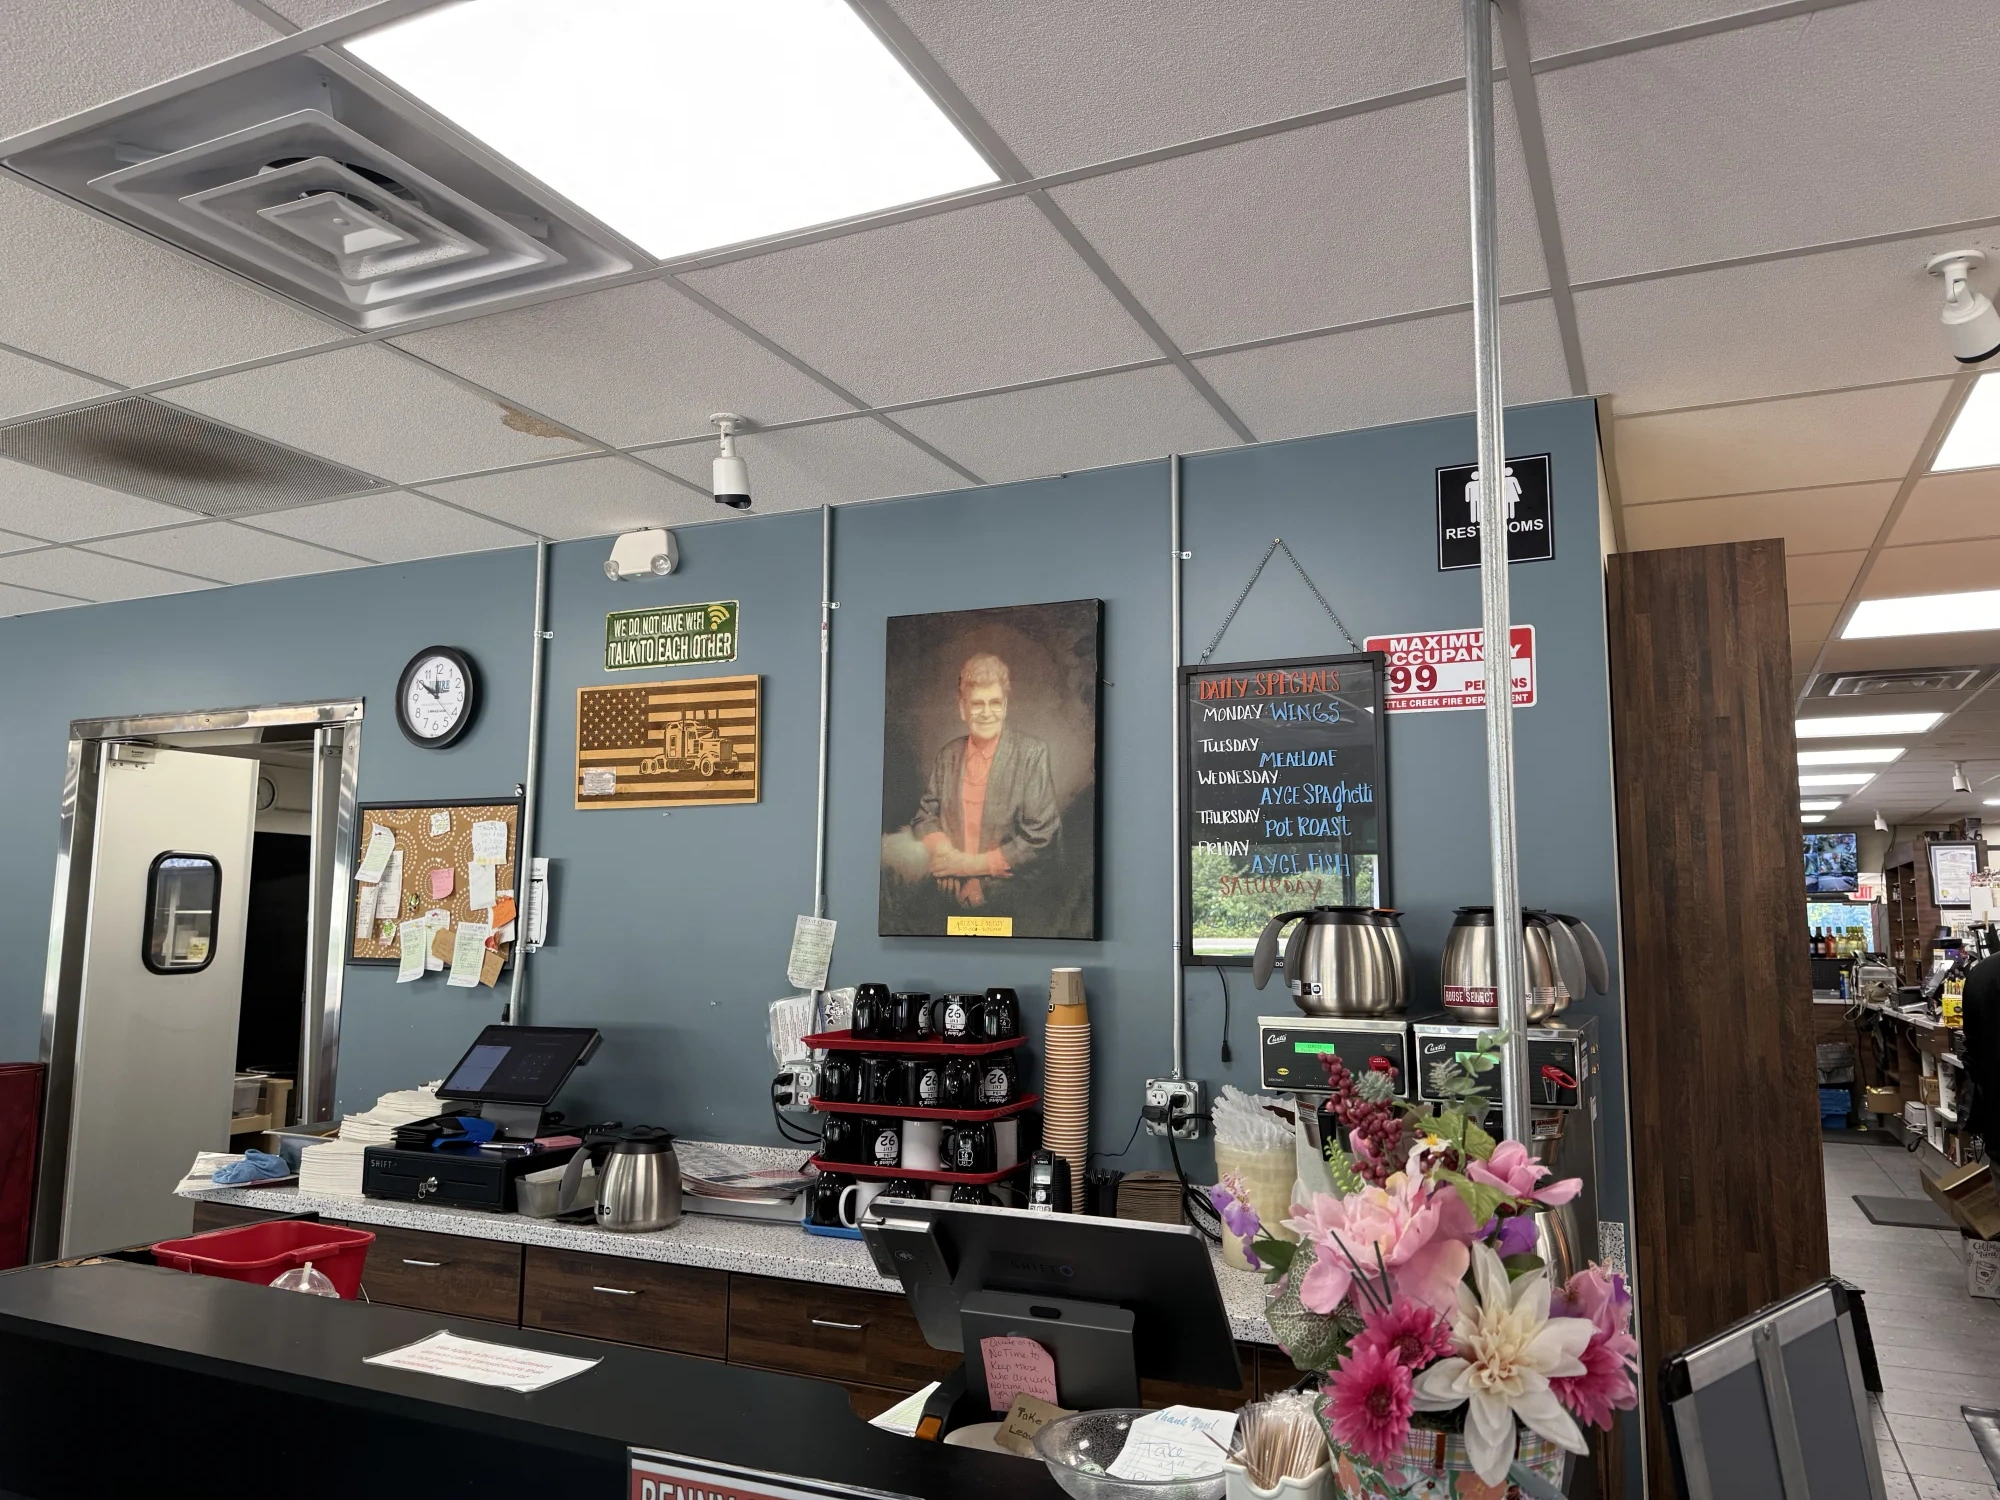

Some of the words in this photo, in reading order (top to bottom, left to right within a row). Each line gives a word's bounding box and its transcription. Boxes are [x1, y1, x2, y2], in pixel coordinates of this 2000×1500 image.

[614, 619, 627, 638] WE
[628, 617, 640, 636] DO
[642, 615, 660, 635] NOT
[661, 613, 684, 634] HAVE
[608, 641, 638, 666] TALK
[640, 639, 654, 663] TO
[658, 635, 689, 661] EACH
[692, 632, 732, 659] OTHER
[1390, 633, 1484, 652] MAXIMU
[1255, 669, 1341, 696] SPECIALS
[1390, 664, 1438, 694] 99
[1409, 698, 1440, 708] CREEK
[1442, 696, 1463, 706] FIRE
[1269, 700, 1341, 724] WINGS
[1465, 991, 1495, 1004] SELECT
[947, 1008, 961, 1018] 92
[1266, 1034, 1287, 1045] Curtis
[1424, 1042, 1447, 1054] Curtis
[925, 1075, 937, 1086] 92
[989, 1073, 1004, 1084] 92
[880, 1135, 895, 1146] 92
[371, 1160, 392, 1168] SHIFT
[1017, 1407, 1043, 1426] Take
[1155, 1410, 1188, 1427] Thank
[1008, 1424, 1034, 1441] Leav
[1138, 1442, 1185, 1459] Take
